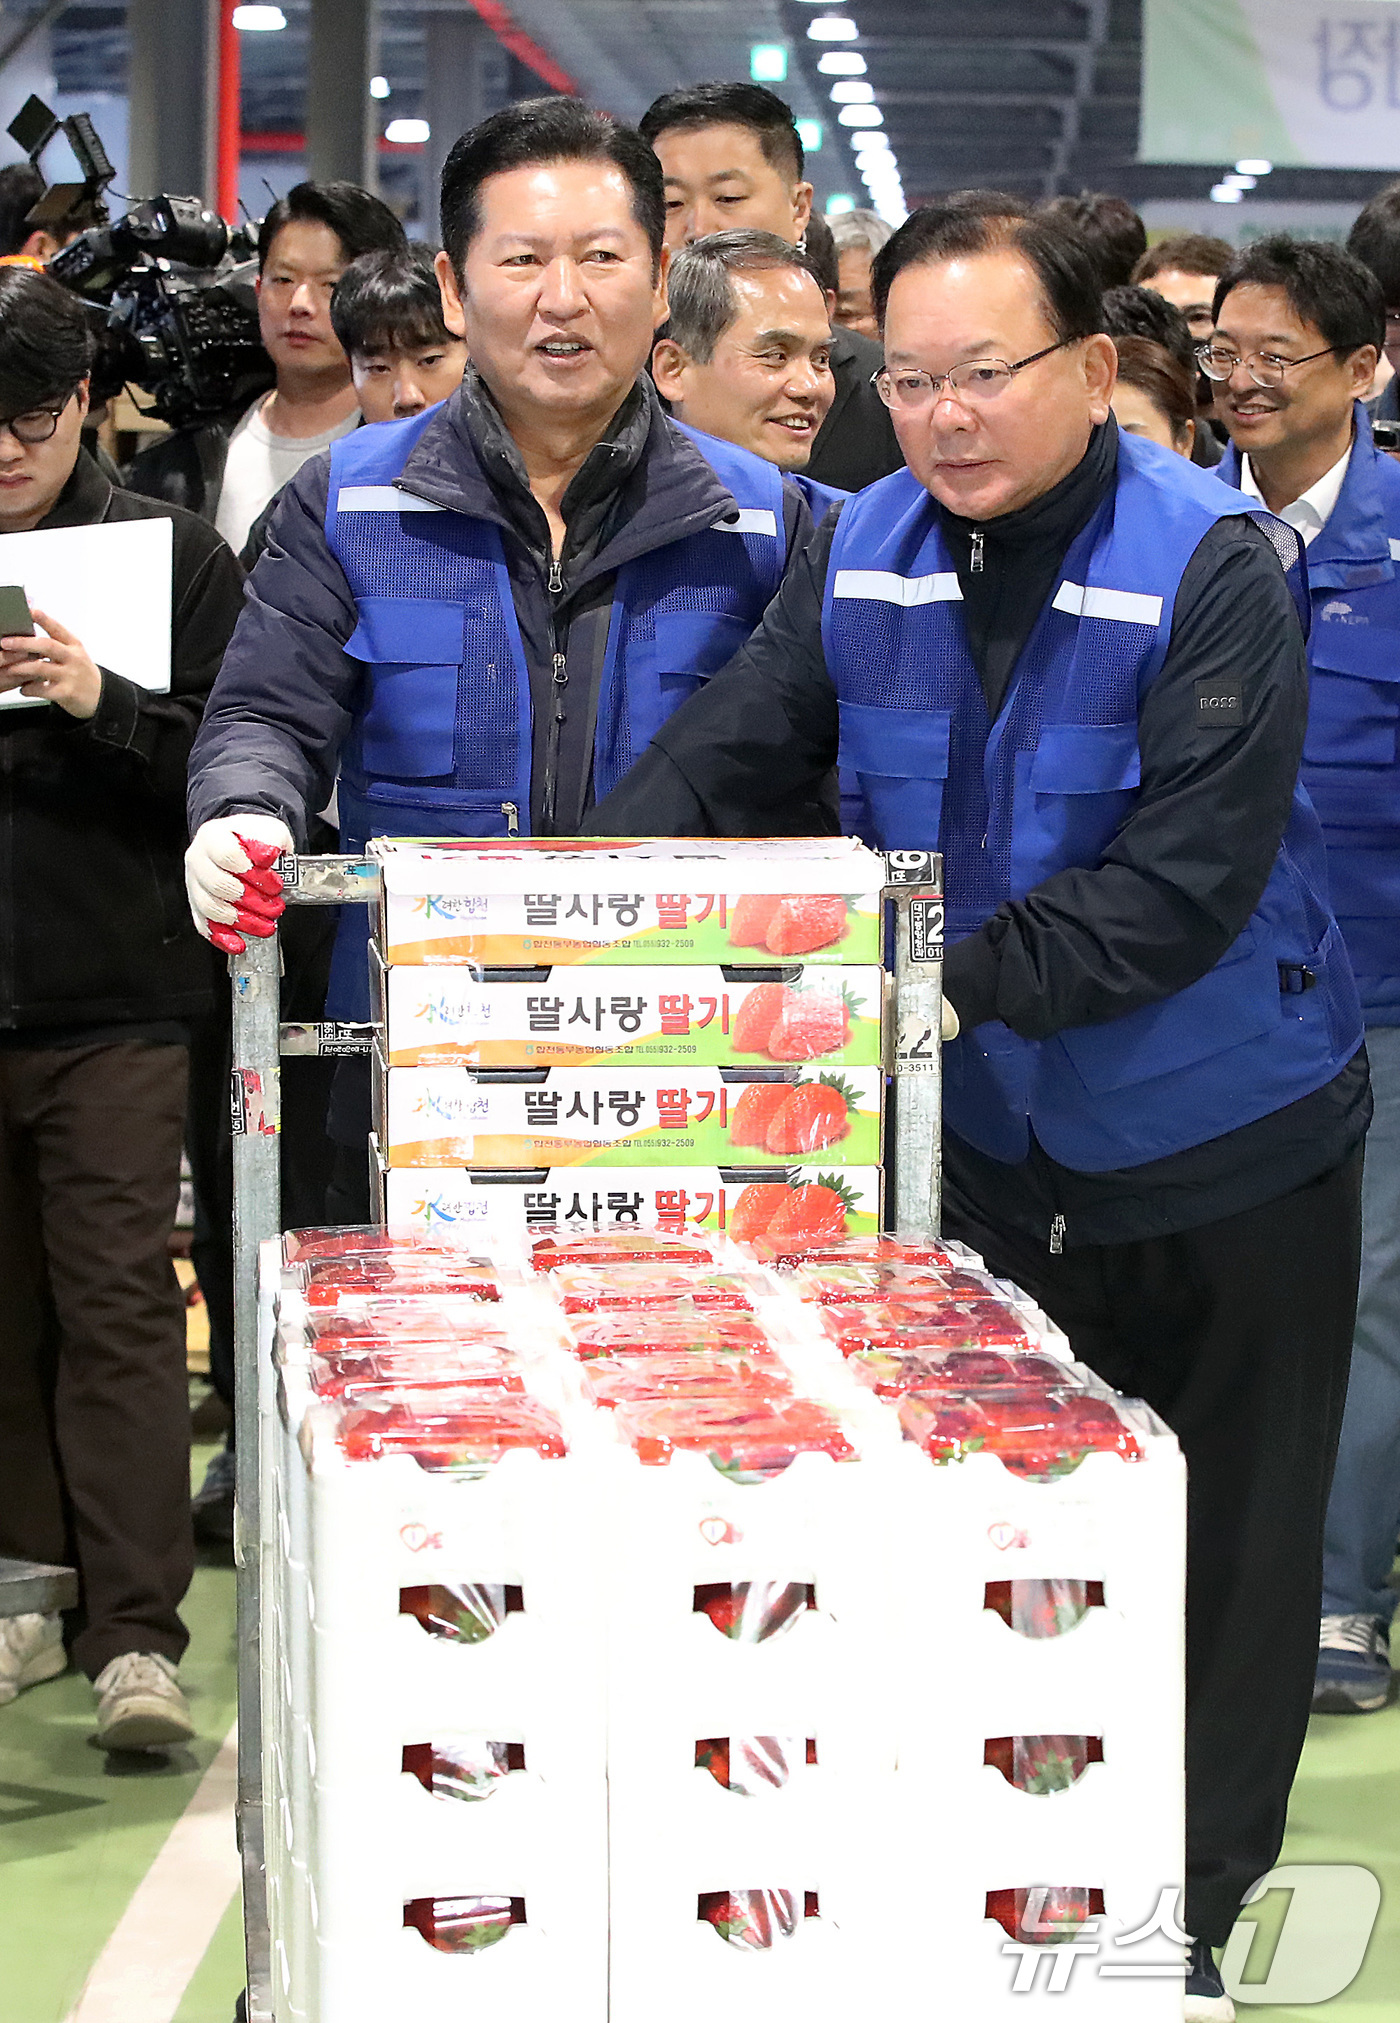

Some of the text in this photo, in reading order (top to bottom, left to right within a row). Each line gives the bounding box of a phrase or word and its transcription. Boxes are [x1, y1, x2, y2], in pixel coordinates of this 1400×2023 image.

[1200, 697, 1237, 709] BOSS
[524, 894, 727, 929] 딸사랑 딸기
[527, 993, 730, 1035] 딸사랑 딸기
[524, 1087, 728, 1129] 딸사랑 딸기
[523, 1188, 726, 1229] 딸사랑 딸기
